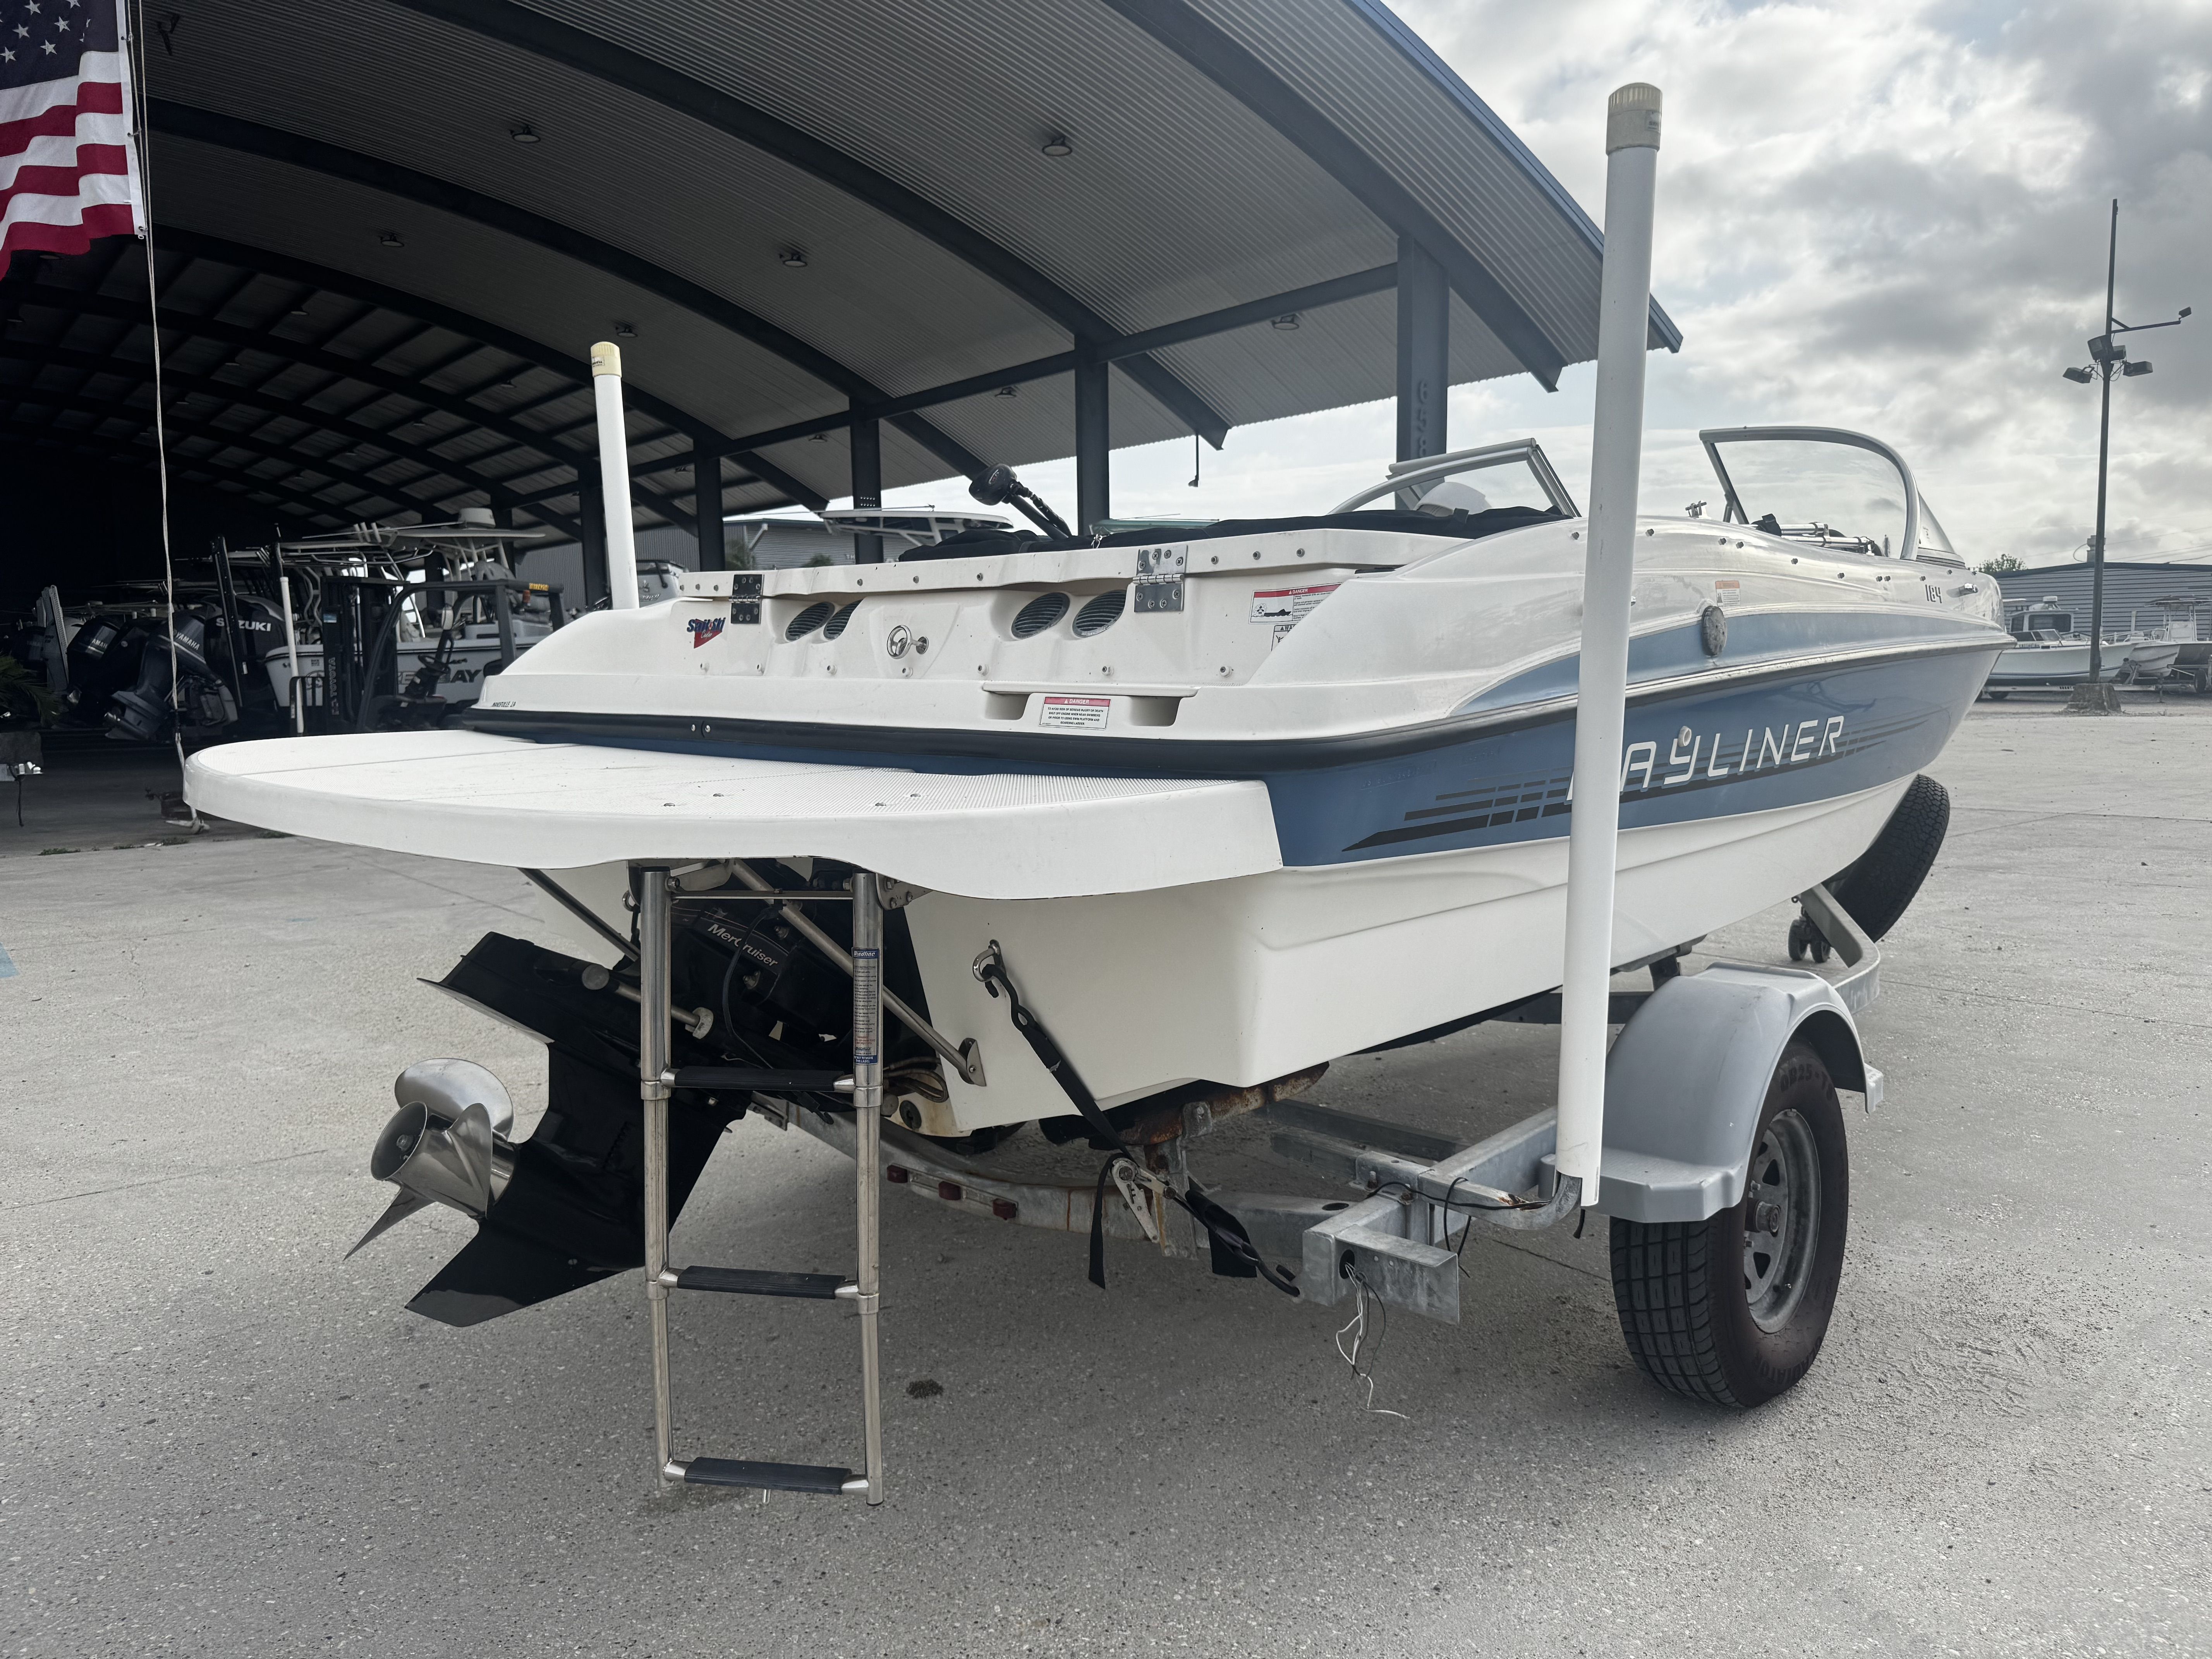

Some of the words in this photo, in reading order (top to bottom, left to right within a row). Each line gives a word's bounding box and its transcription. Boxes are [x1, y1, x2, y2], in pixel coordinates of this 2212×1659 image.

[1925, 584, 1942, 603] 184
[216, 618, 271, 632] SZUKI
[176, 631, 200, 650] YAMAHA
[329, 657, 337, 697] TOYOTA
[1566, 715, 1844, 801] AYLINER
